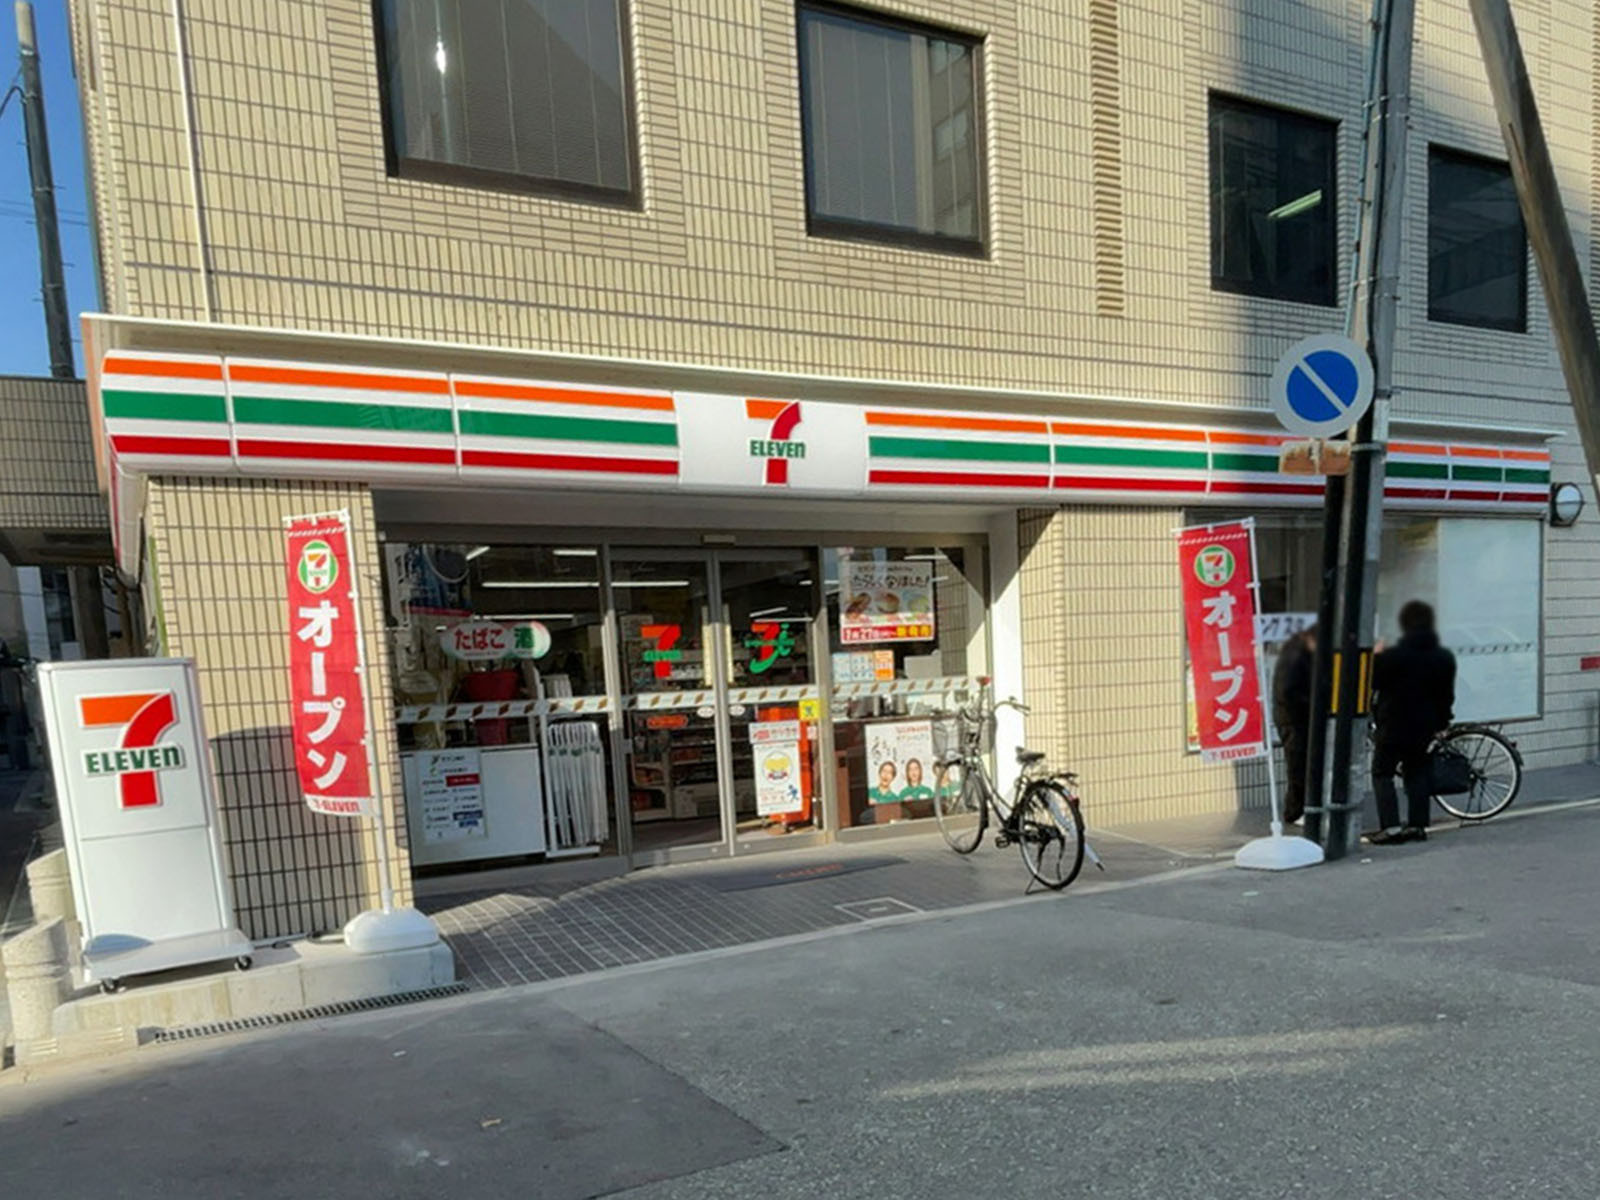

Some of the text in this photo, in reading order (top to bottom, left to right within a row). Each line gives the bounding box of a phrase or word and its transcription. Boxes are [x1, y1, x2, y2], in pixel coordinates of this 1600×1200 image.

[745, 399, 801, 485] 7
[297, 600, 347, 789] オープン
[454, 627, 505, 650] たばこ
[1202, 591, 1249, 741] オープン
[80, 692, 175, 808] 7
